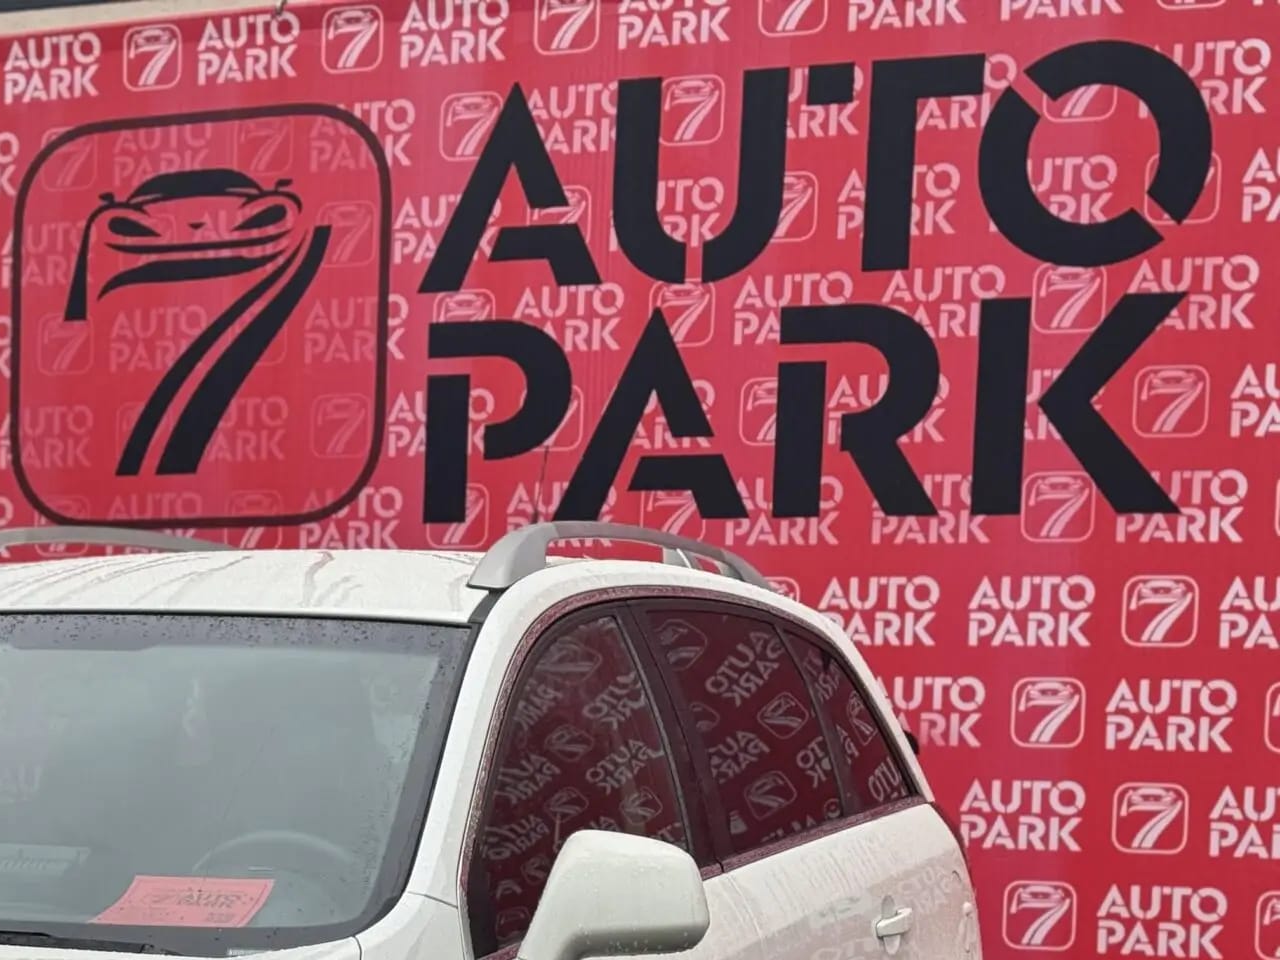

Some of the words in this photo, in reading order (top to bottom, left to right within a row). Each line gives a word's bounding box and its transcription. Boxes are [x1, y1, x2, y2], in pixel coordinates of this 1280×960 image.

[197, 12, 300, 52] AUTO
[400, 0, 509, 33] AUTO
[618, 7, 730, 50] PARK
[848, 0, 967, 32] PARK
[4, 32, 101, 73] AUTO
[197, 43, 297, 85] PARK
[400, 27, 505, 69] PARK
[1154, 38, 1271, 77] UTO
[4, 63, 98, 104] PARK
[418, 39, 1213, 293] AUTO
[837, 163, 960, 204] ATO
[1027, 154, 1118, 193] UTO
[734, 271, 853, 310] AUTO
[882, 264, 1006, 303] AUTO
[1126, 254, 1260, 294] AUTO
[513, 282, 625, 319] AUTO
[110, 304, 207, 340] AUTO
[109, 338, 186, 373] PAR
[423, 291, 1189, 524] PARK
[1229, 400, 1280, 438] PA
[207, 429, 287, 462] ARK
[299, 520, 400, 549] PARK
[724, 511, 840, 546] PARK
[871, 510, 991, 545] PARK
[1115, 506, 1245, 544] PARK
[818, 575, 940, 611] AUTO
[969, 575, 1095, 610] AUTO
[1220, 575, 1280, 613] AU
[968, 610, 1091, 647] PARK
[1219, 612, 1280, 650] PA
[1106, 679, 1237, 716] AUTO
[1106, 713, 1232, 752] PARK
[959, 779, 1086, 816] AUTO
[1209, 785, 1280, 822] AU
[960, 815, 1082, 852] PARK
[1209, 822, 1280, 860] PA
[1097, 885, 1227, 923] AUTO
[1097, 919, 1222, 959] PARK
